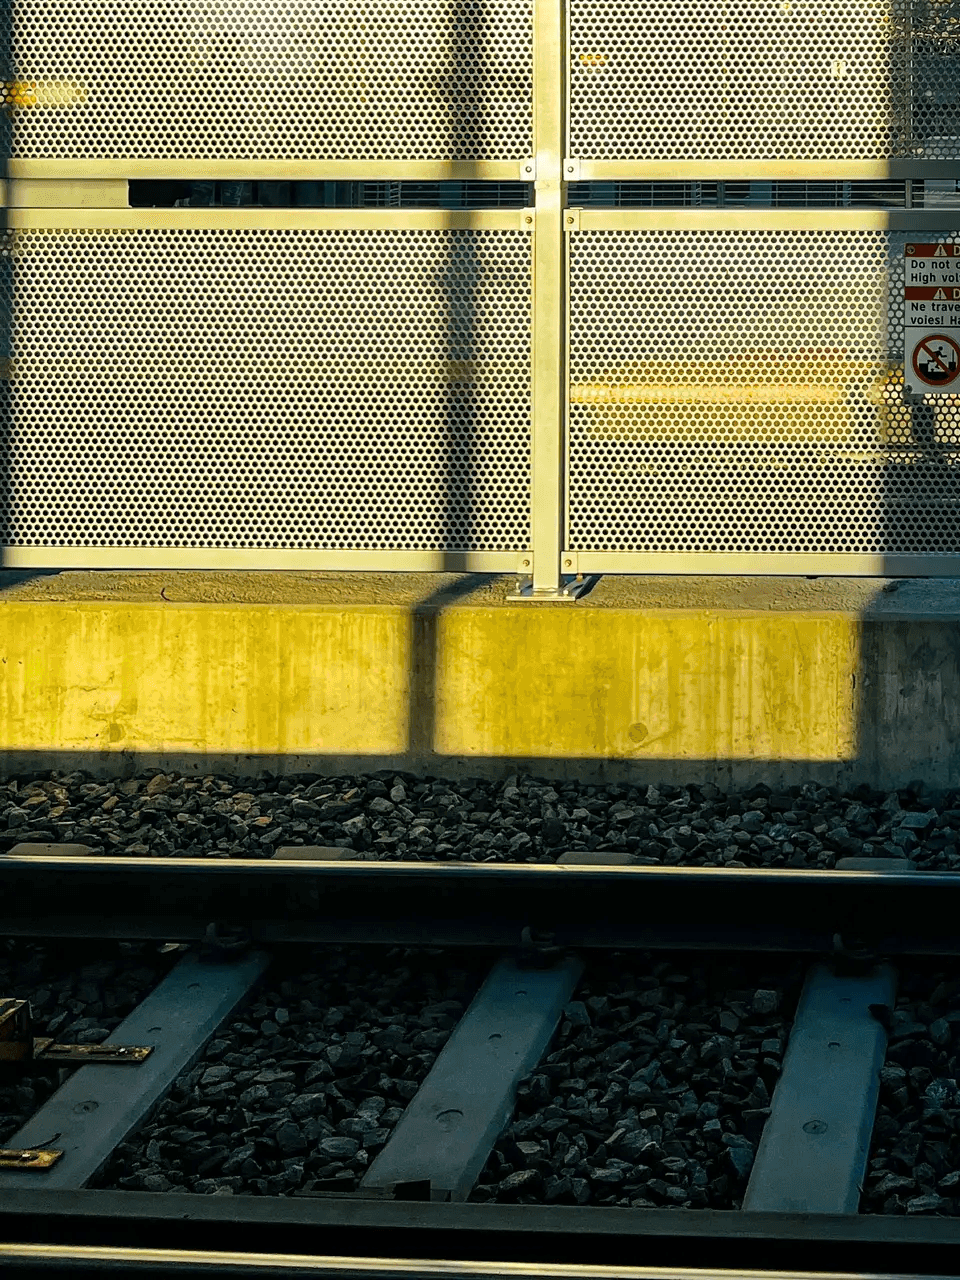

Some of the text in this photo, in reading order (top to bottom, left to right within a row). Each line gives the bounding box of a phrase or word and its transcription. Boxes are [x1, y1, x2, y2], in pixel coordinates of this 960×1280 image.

[911, 259, 926, 269] Do
[931, 259, 950, 269] not
[911, 272, 936, 285] High
[911, 302, 926, 312] Ne
[910, 315, 944, 325] voies!
